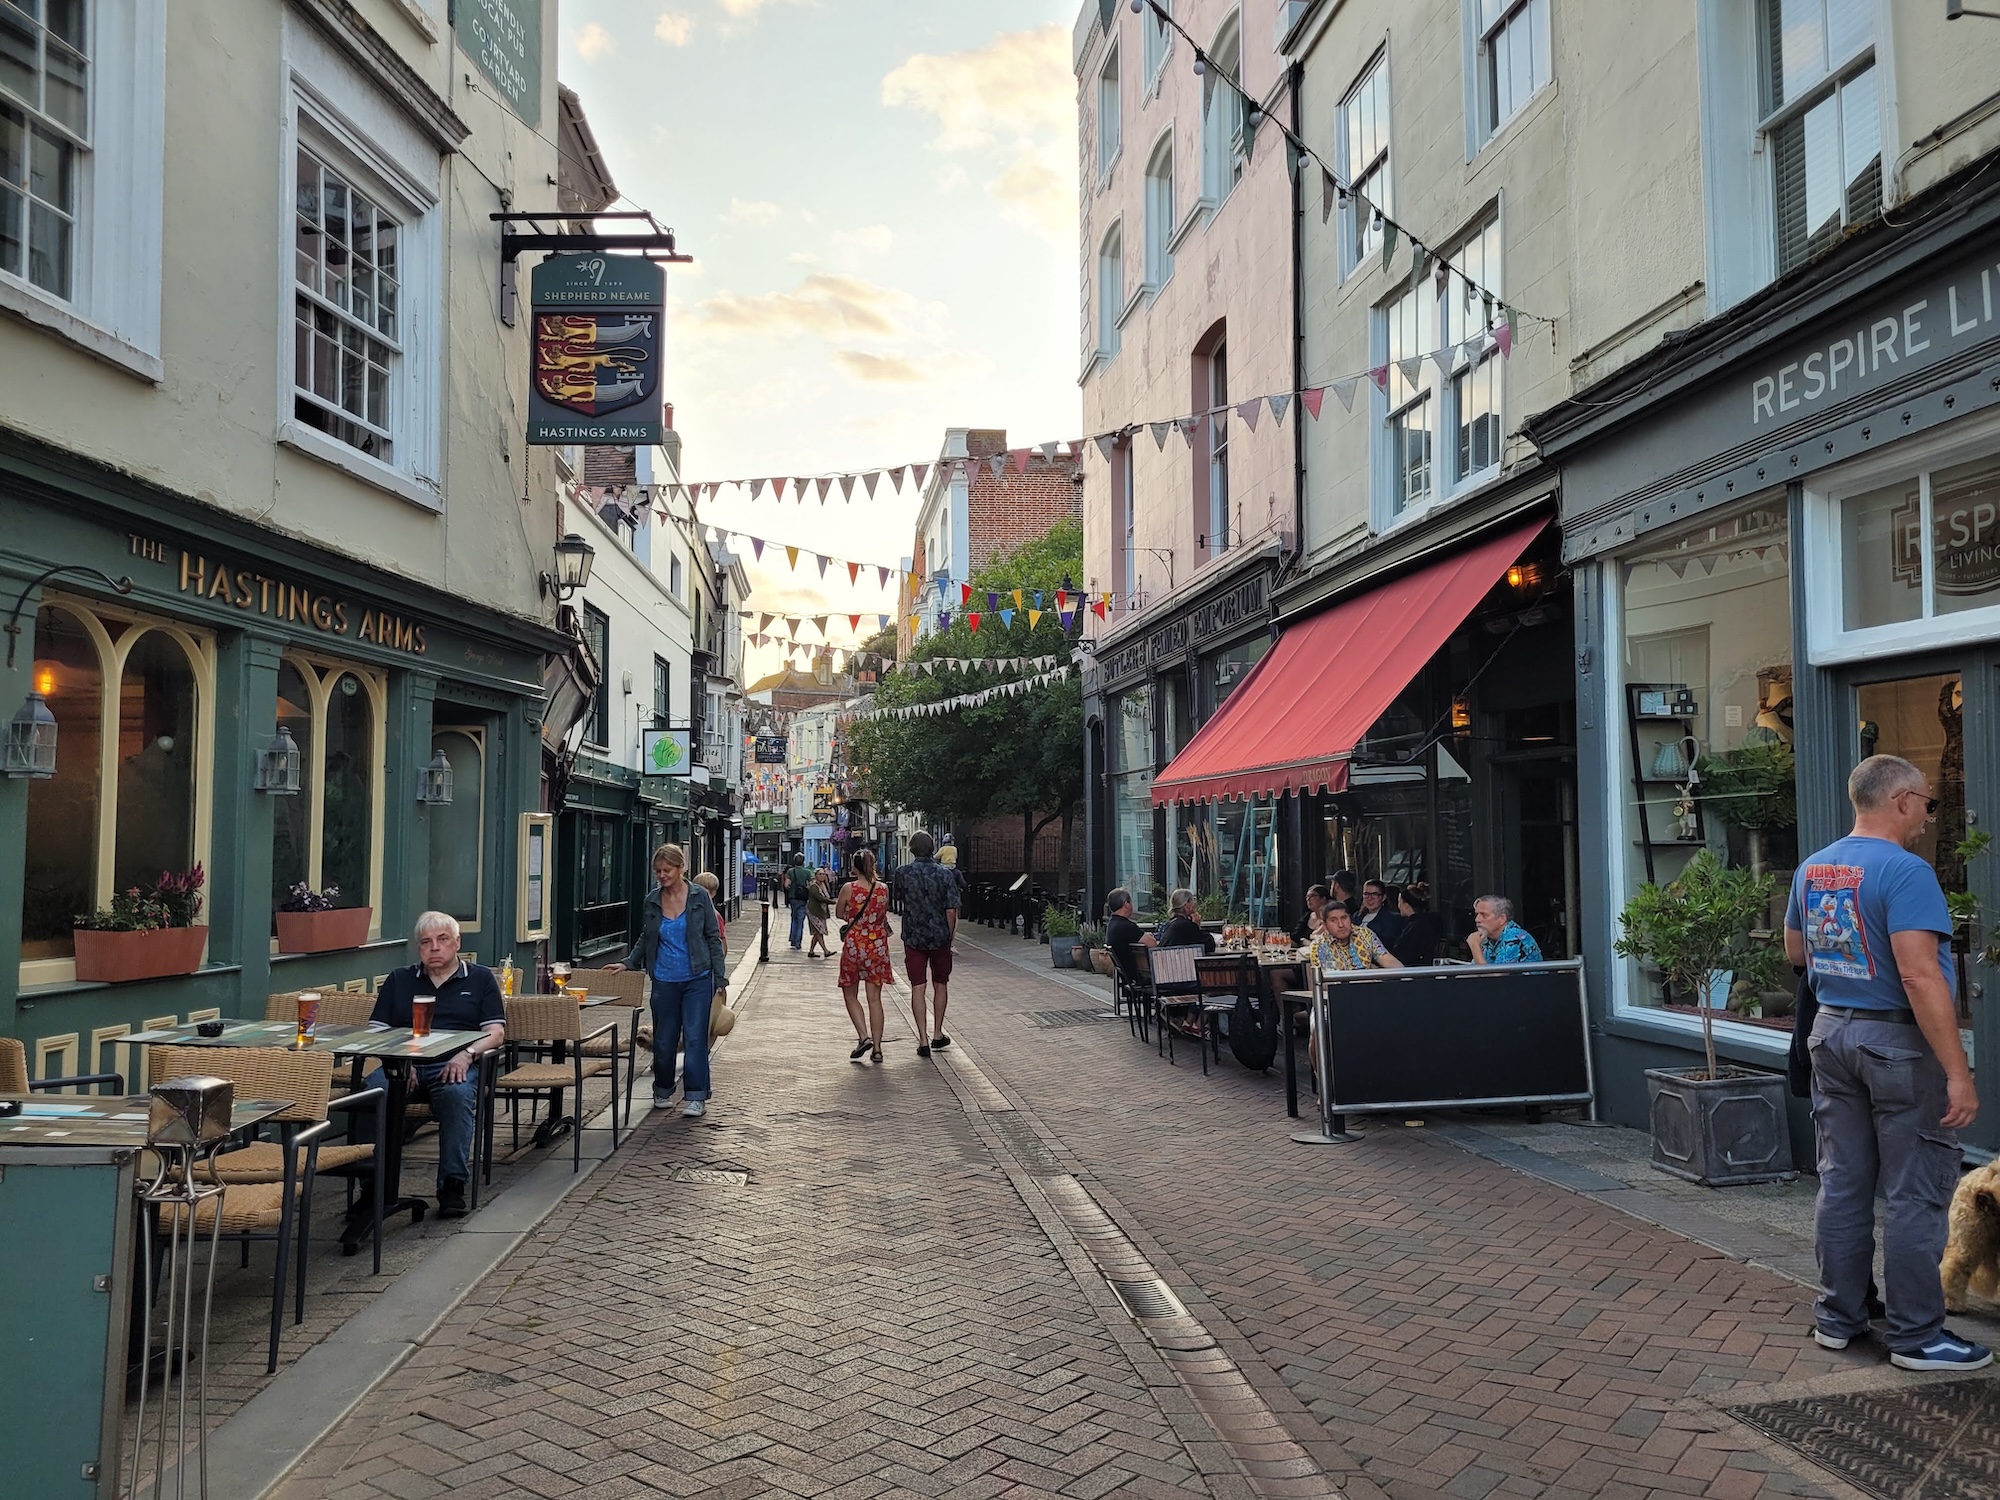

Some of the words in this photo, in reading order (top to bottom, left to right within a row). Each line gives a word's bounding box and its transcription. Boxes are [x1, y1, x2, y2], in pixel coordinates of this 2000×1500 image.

[477, 0, 504, 34] OCAL
[508, 28, 525, 58] PUB
[493, 0, 525, 40] ENDLY
[472, 18, 527, 93] COURTYARD
[481, 49, 519, 102] GARDEN
[544, 291, 607, 301] SHEPHERD
[610, 291, 651, 301] NEAME
[1752, 299, 1931, 424] RESPIRE
[1948, 263, 2000, 337] LI
[539, 427, 606, 438] HASTINGS
[610, 427, 648, 438] ARMS
[1905, 501, 2000, 559] RESP
[129, 533, 167, 564] THE
[179, 550, 349, 635] HASTINGS
[358, 608, 426, 655] ARMS
[1150, 619, 1187, 661] FAMED
[1193, 577, 1263, 640] EMPORIUM
[1302, 766, 1331, 783] DRAGON
[1823, 877, 1864, 891] FUTURE
